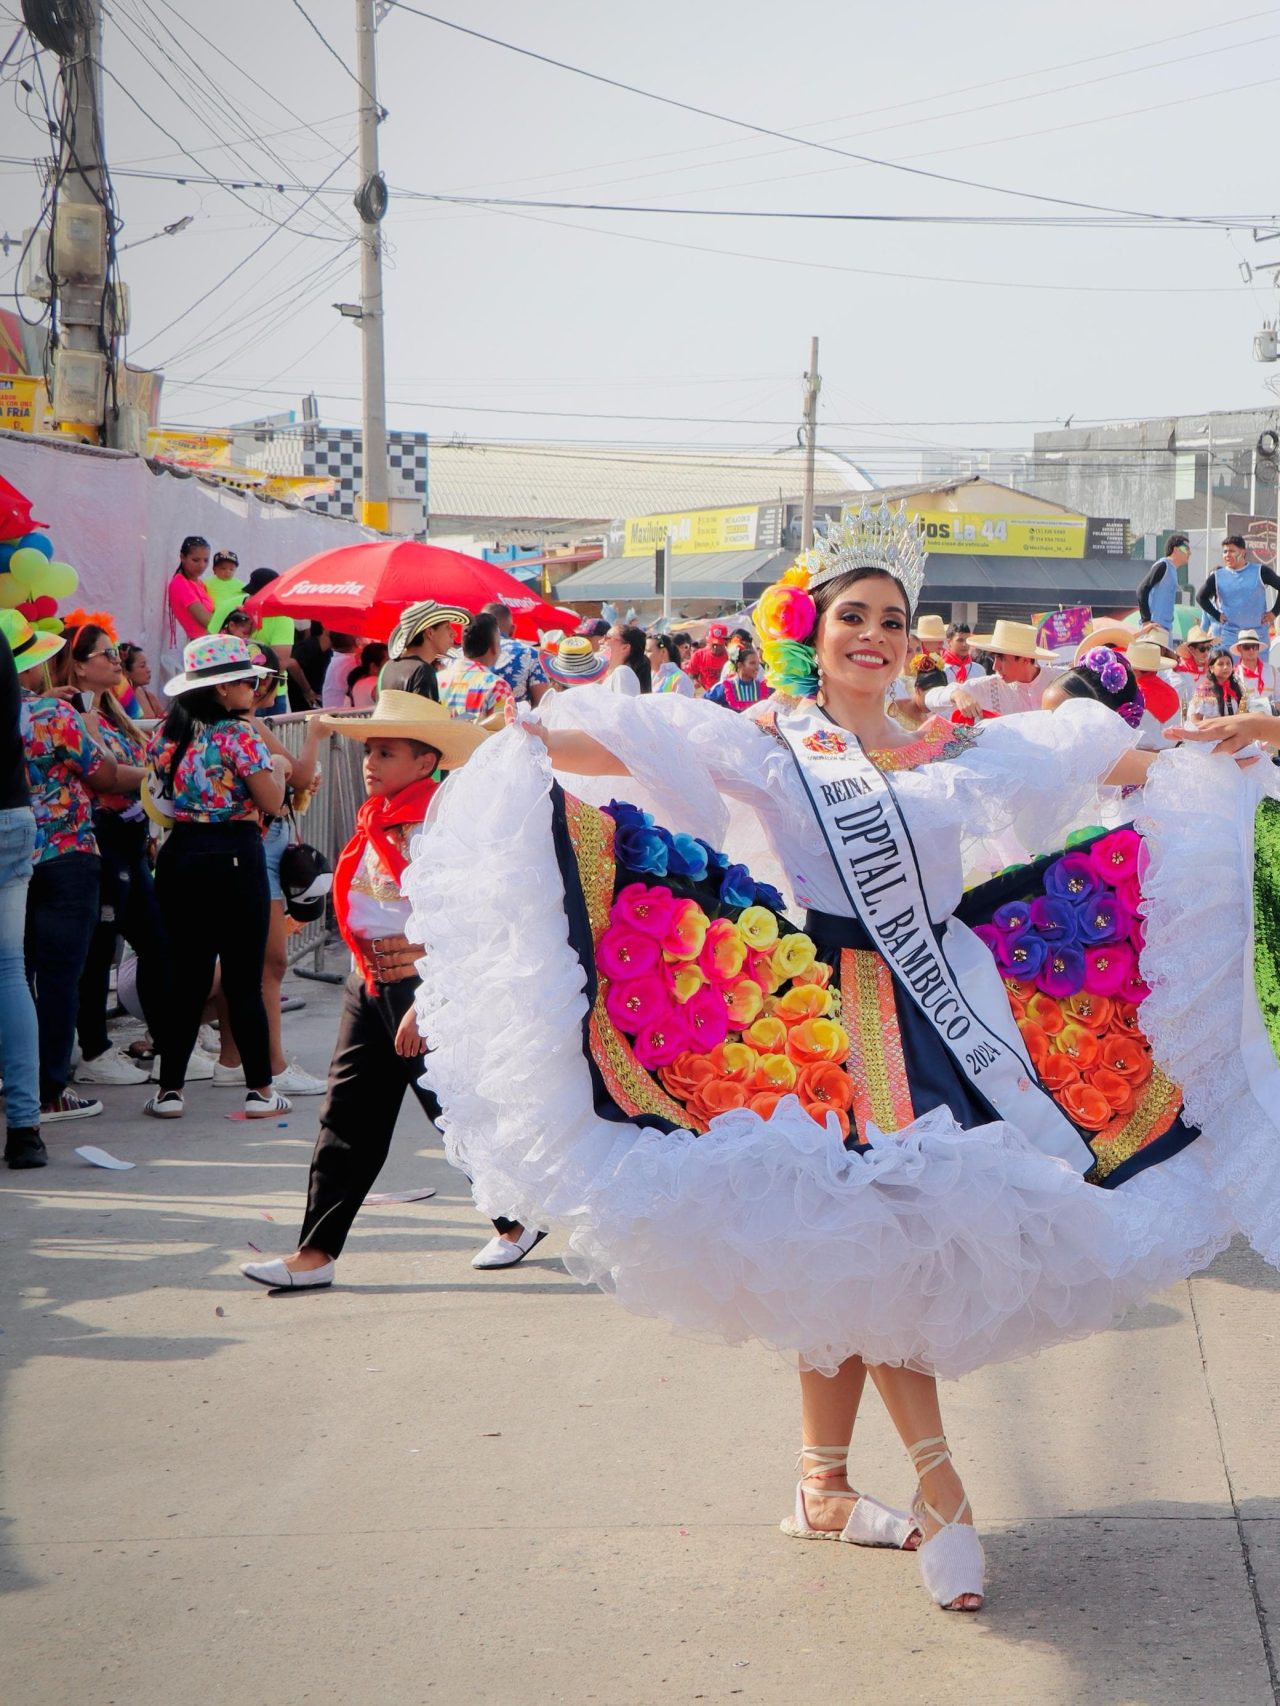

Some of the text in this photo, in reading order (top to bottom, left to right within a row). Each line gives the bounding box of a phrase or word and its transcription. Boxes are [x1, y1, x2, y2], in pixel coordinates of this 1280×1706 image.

[630, 521, 668, 545] Maxilujos
[953, 518, 976, 540] La
[981, 518, 1007, 541] 44
[1244, 540, 1269, 550] TREET
[820, 775, 873, 807] REINA
[834, 800, 971, 1041] DPTAL. BAMBUCO
[965, 1040, 1002, 1076] 2024
